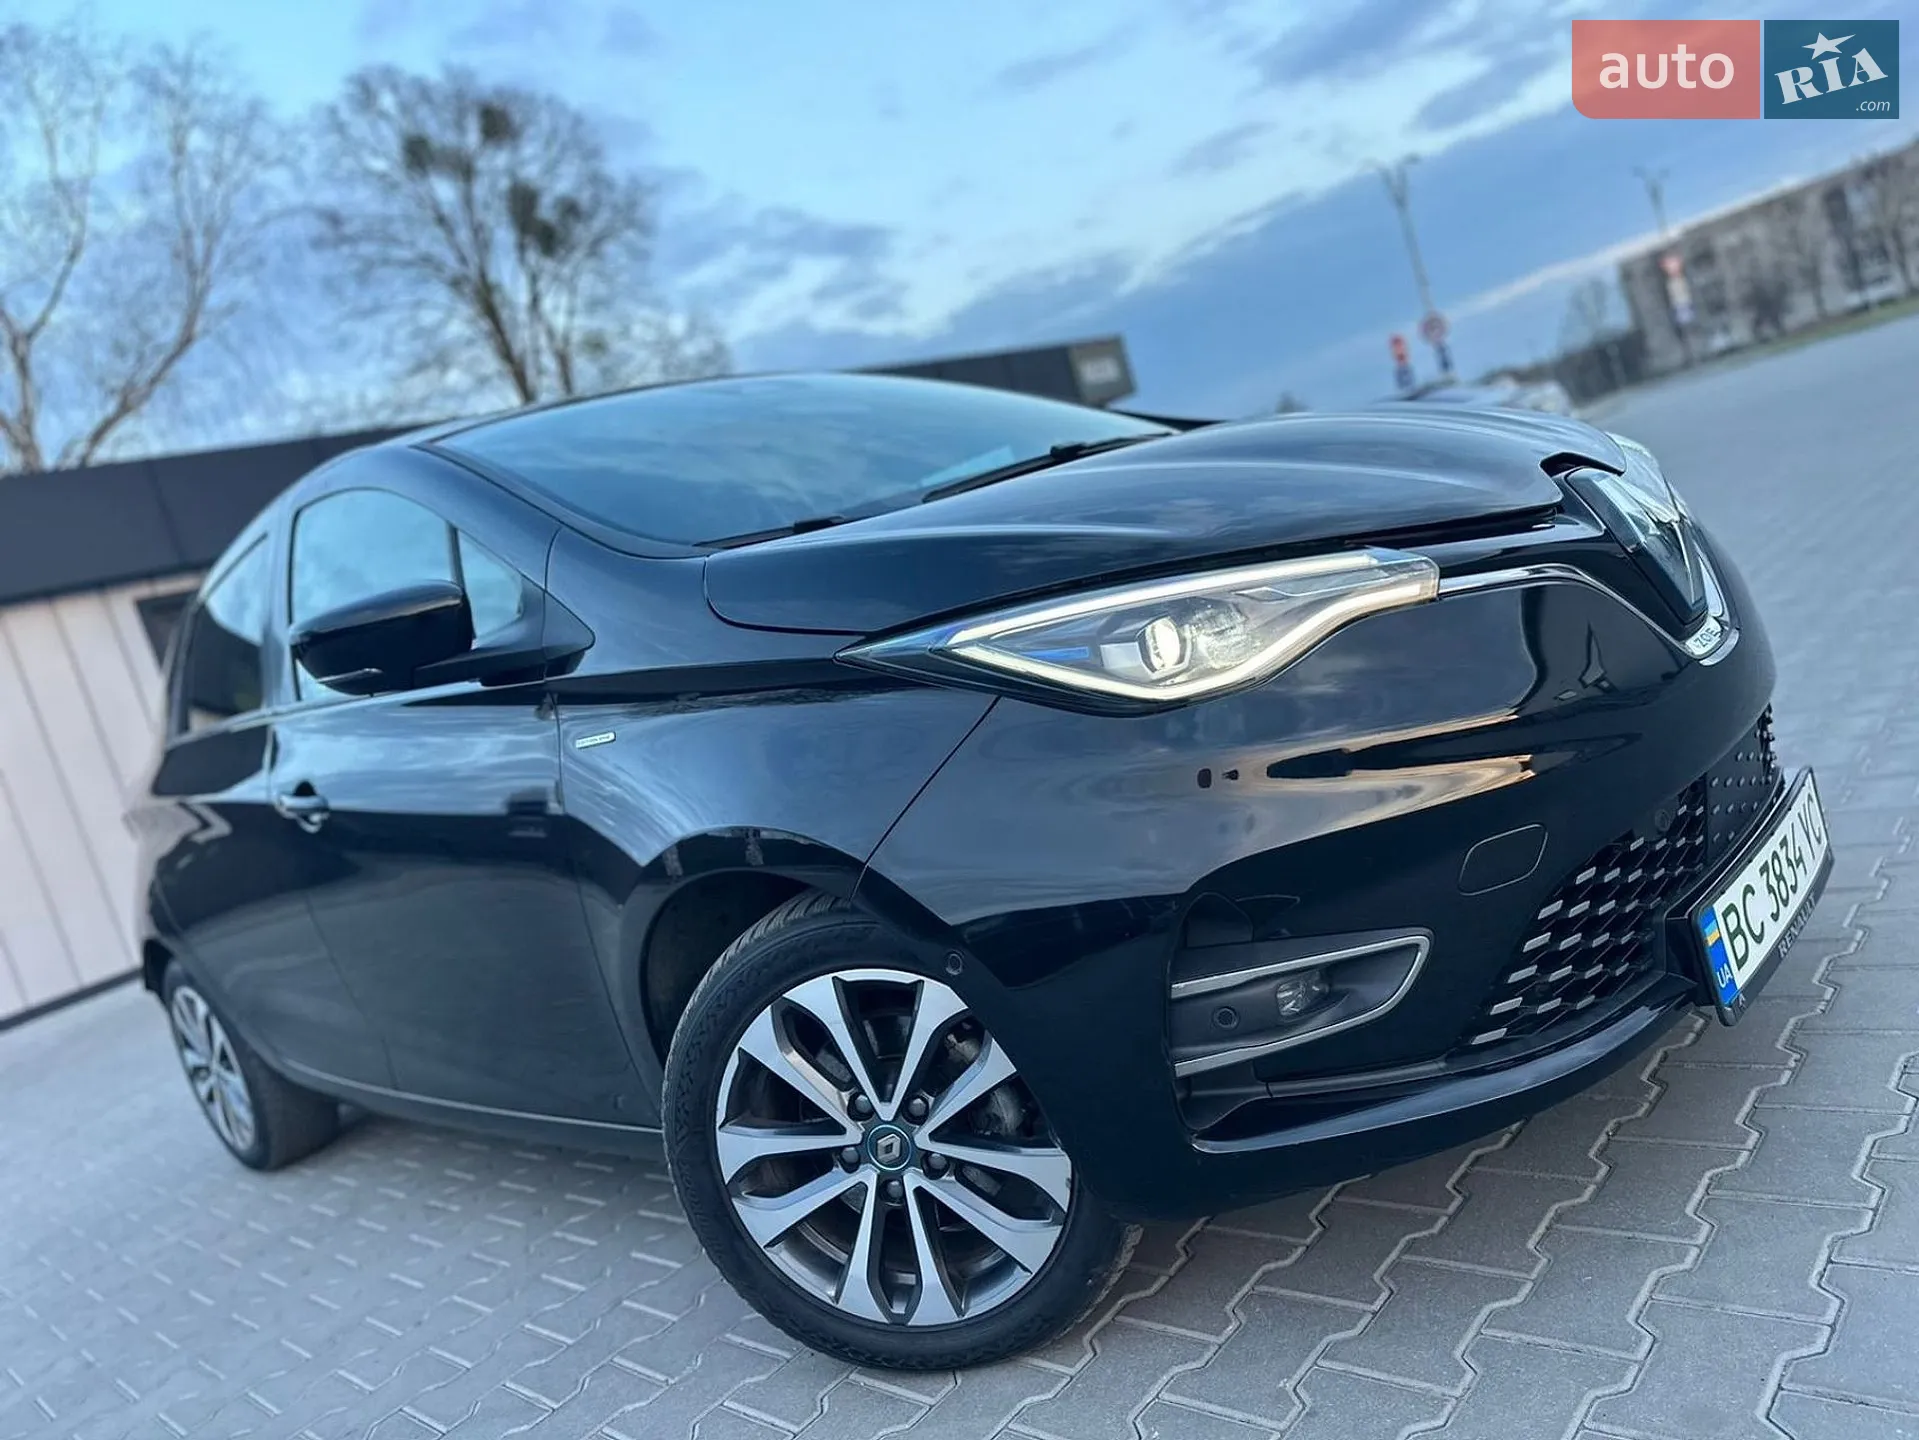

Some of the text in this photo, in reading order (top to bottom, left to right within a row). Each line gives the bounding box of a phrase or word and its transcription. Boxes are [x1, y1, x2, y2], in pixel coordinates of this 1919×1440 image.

[1693, 627, 1721, 647] ZOE
[1721, 792, 1822, 971] BC 3834 YC
[1777, 891, 1816, 959] RENAULT
[1717, 962, 1733, 988] UA
